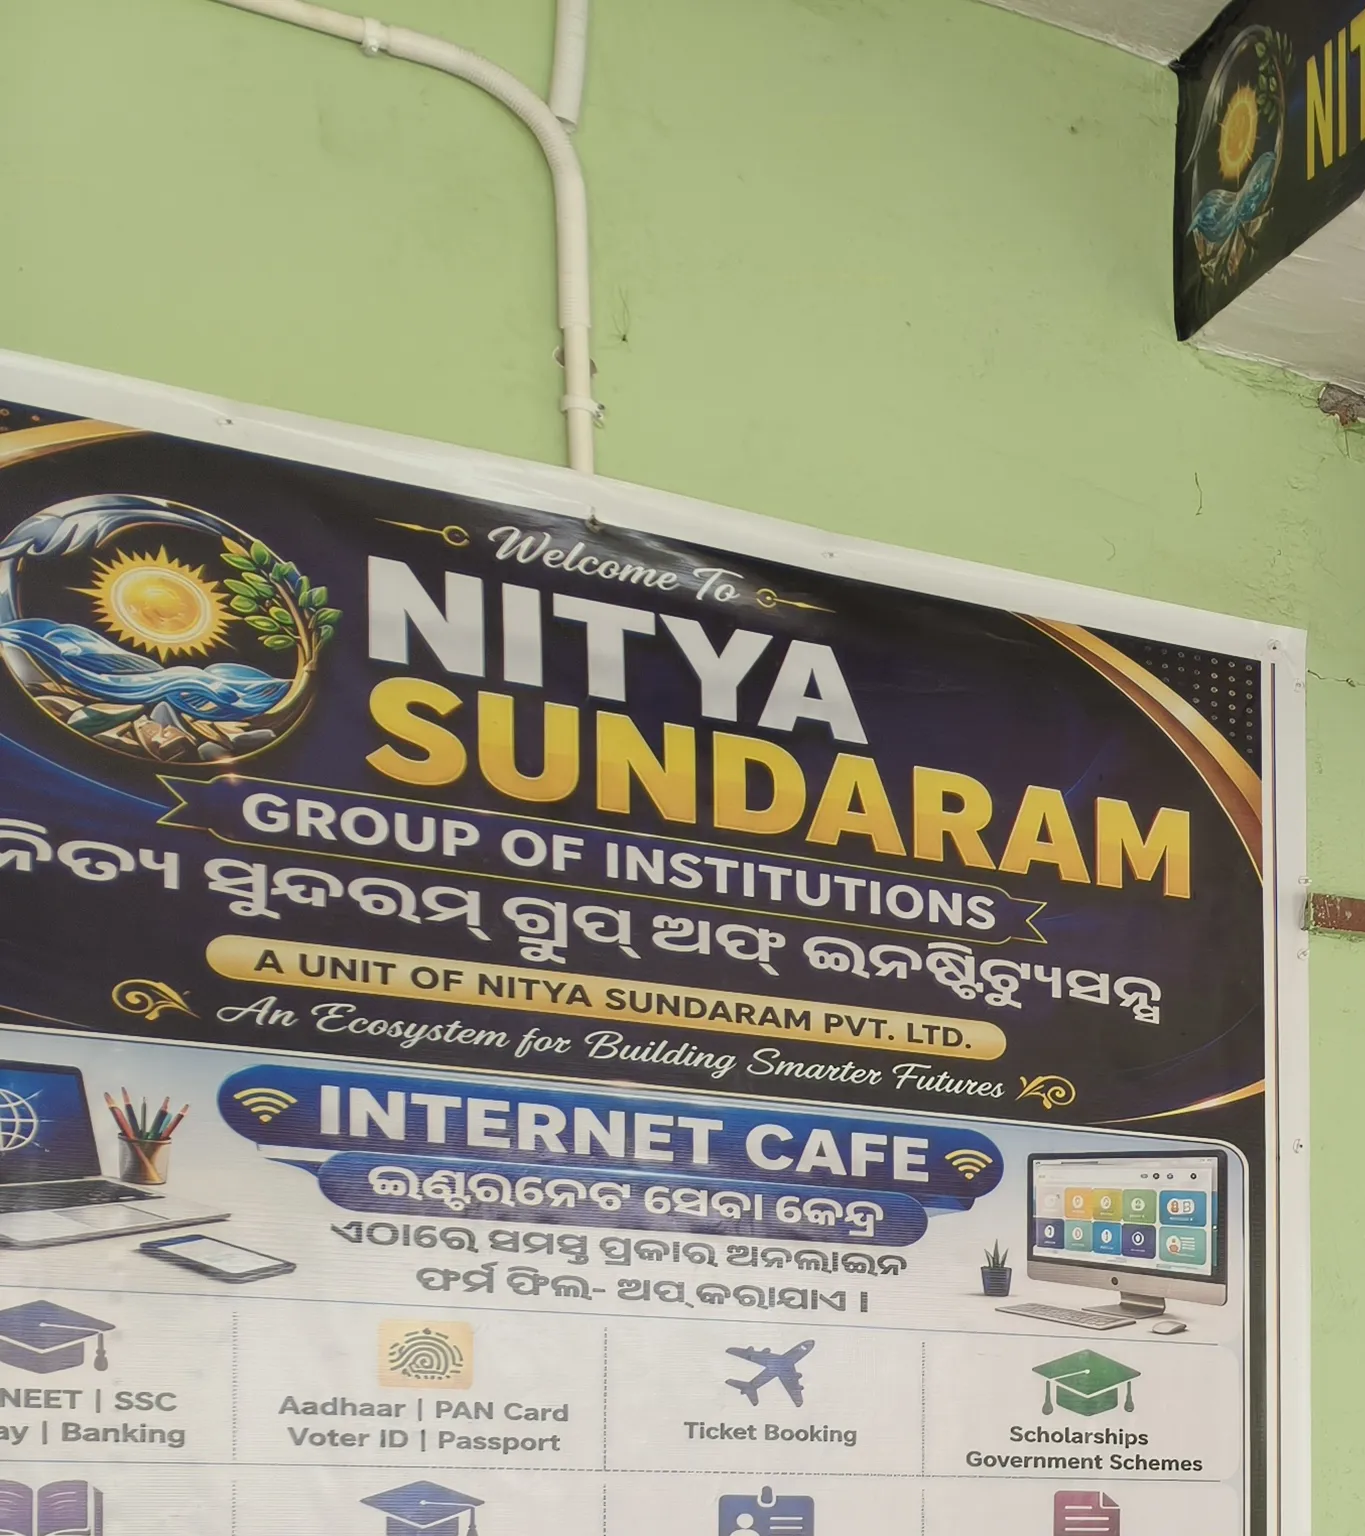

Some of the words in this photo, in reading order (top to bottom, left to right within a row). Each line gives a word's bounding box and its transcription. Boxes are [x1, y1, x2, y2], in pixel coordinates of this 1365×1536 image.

[487, 525, 678, 591] Welcome
[692, 567, 741, 604] To
[368, 555, 868, 744] NITYA
[365, 676, 1190, 898] SUNDARAM
[242, 793, 480, 857] GROUP
[501, 828, 584, 871] OF
[606, 843, 996, 930] INSTITUTIONS
[216, 996, 298, 1028] An
[310, 1001, 510, 1051] Ecosystem
[517, 1028, 570, 1060] for
[584, 1031, 737, 1079] Building
[746, 1048, 882, 1086] Smarter
[892, 1063, 1006, 1100] Futures
[320, 1084, 723, 1164] INTERNET
[746, 1123, 929, 1182] CAFE
[62, 1422, 185, 1448] Banking
[279, 1396, 406, 1417] Aadhaar
[435, 1400, 494, 1421] PAN
[504, 1401, 569, 1422] Card
[684, 1421, 756, 1441] Ticket
[764, 1424, 857, 1446] Booking
[287, 1428, 367, 1448] Voter
[380, 1428, 408, 1449] ID
[438, 1431, 560, 1454] Passport
[966, 1450, 1102, 1471] Government
[1109, 1454, 1203, 1473] Schemes
[1010, 1425, 1149, 1447] Scholarships
